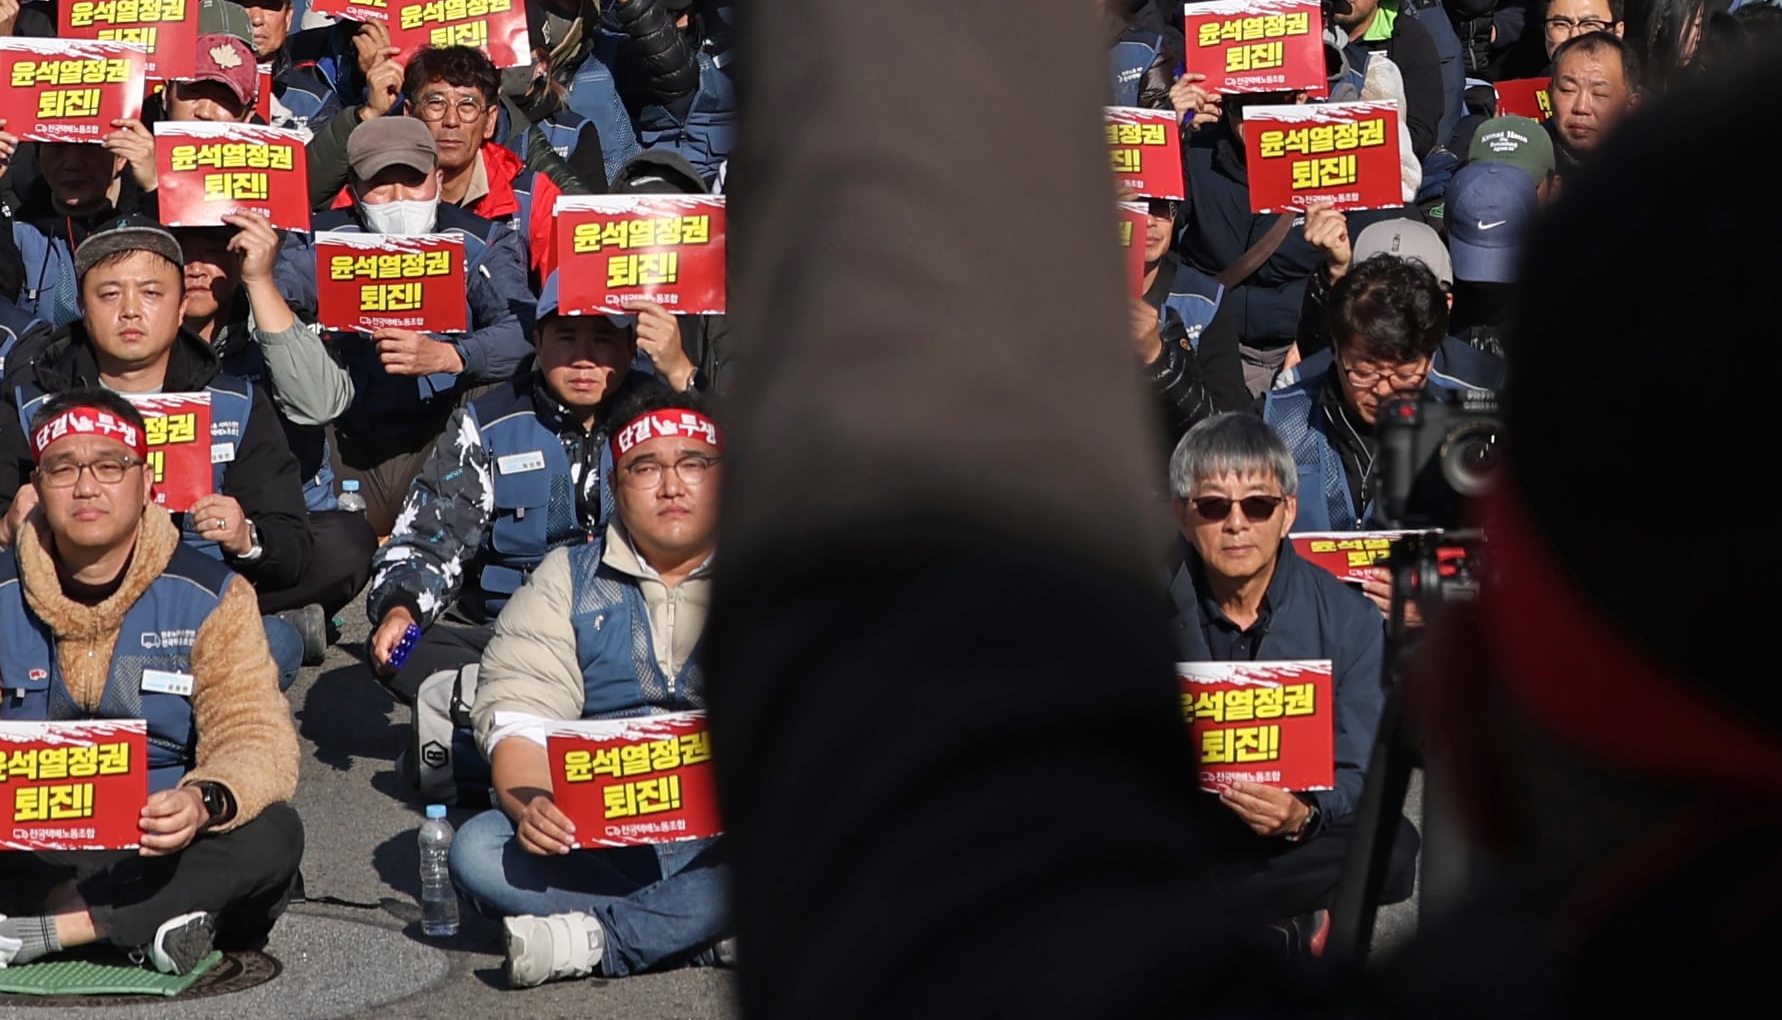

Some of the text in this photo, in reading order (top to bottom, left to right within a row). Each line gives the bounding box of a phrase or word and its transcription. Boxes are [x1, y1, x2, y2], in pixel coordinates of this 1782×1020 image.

[1199, 13, 1310, 46] 윤석열정권
[11, 59, 128, 87] 윤석열정권
[1225, 41, 1284, 72] 퇴진!
[37, 89, 102, 118] 퇴진!
[1260, 119, 1385, 158] 윤석열정권
[171, 143, 294, 171] 윤석열정권
[1292, 155, 1357, 189] 퇴진!
[204, 173, 269, 200] 퇴진!
[574, 215, 710, 253] 윤석열정권
[331, 251, 451, 280] 윤석열정권
[607, 253, 679, 287] 퇴진!
[360, 282, 423, 311] 퇴진!
[36, 412, 137, 452] 단결 투쟁
[618, 413, 717, 454] 단결 투쟁
[1200, 725, 1281, 764] 퇴진!
[13, 783, 94, 822] 퇴진!
[603, 775, 681, 819] 퇴진!
